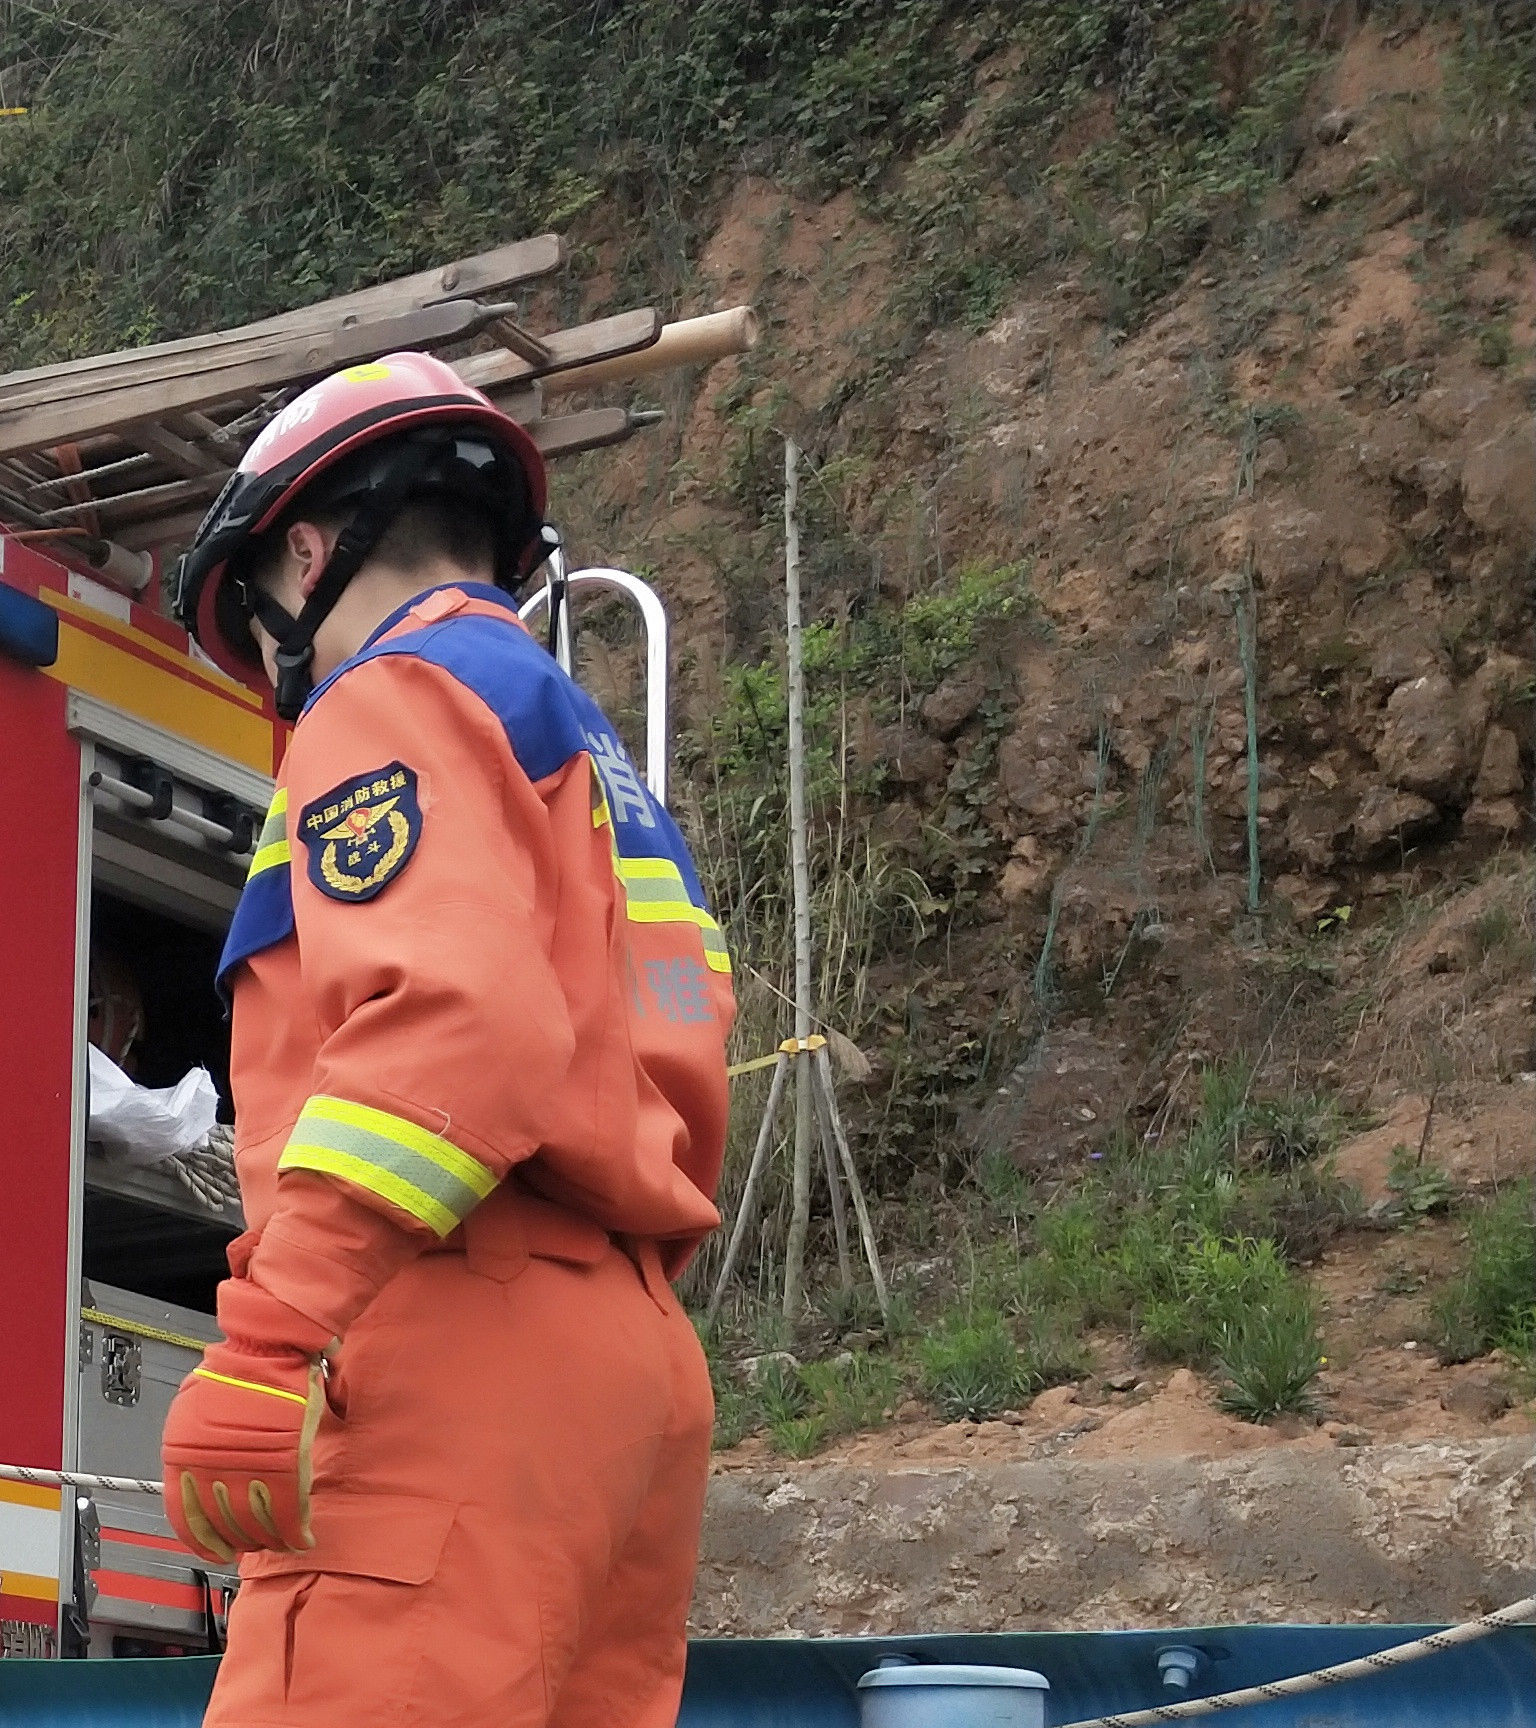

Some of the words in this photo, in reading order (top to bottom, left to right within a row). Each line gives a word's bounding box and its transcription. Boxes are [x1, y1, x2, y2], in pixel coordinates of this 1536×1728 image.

[306, 770, 407, 831] 中国消防救援
